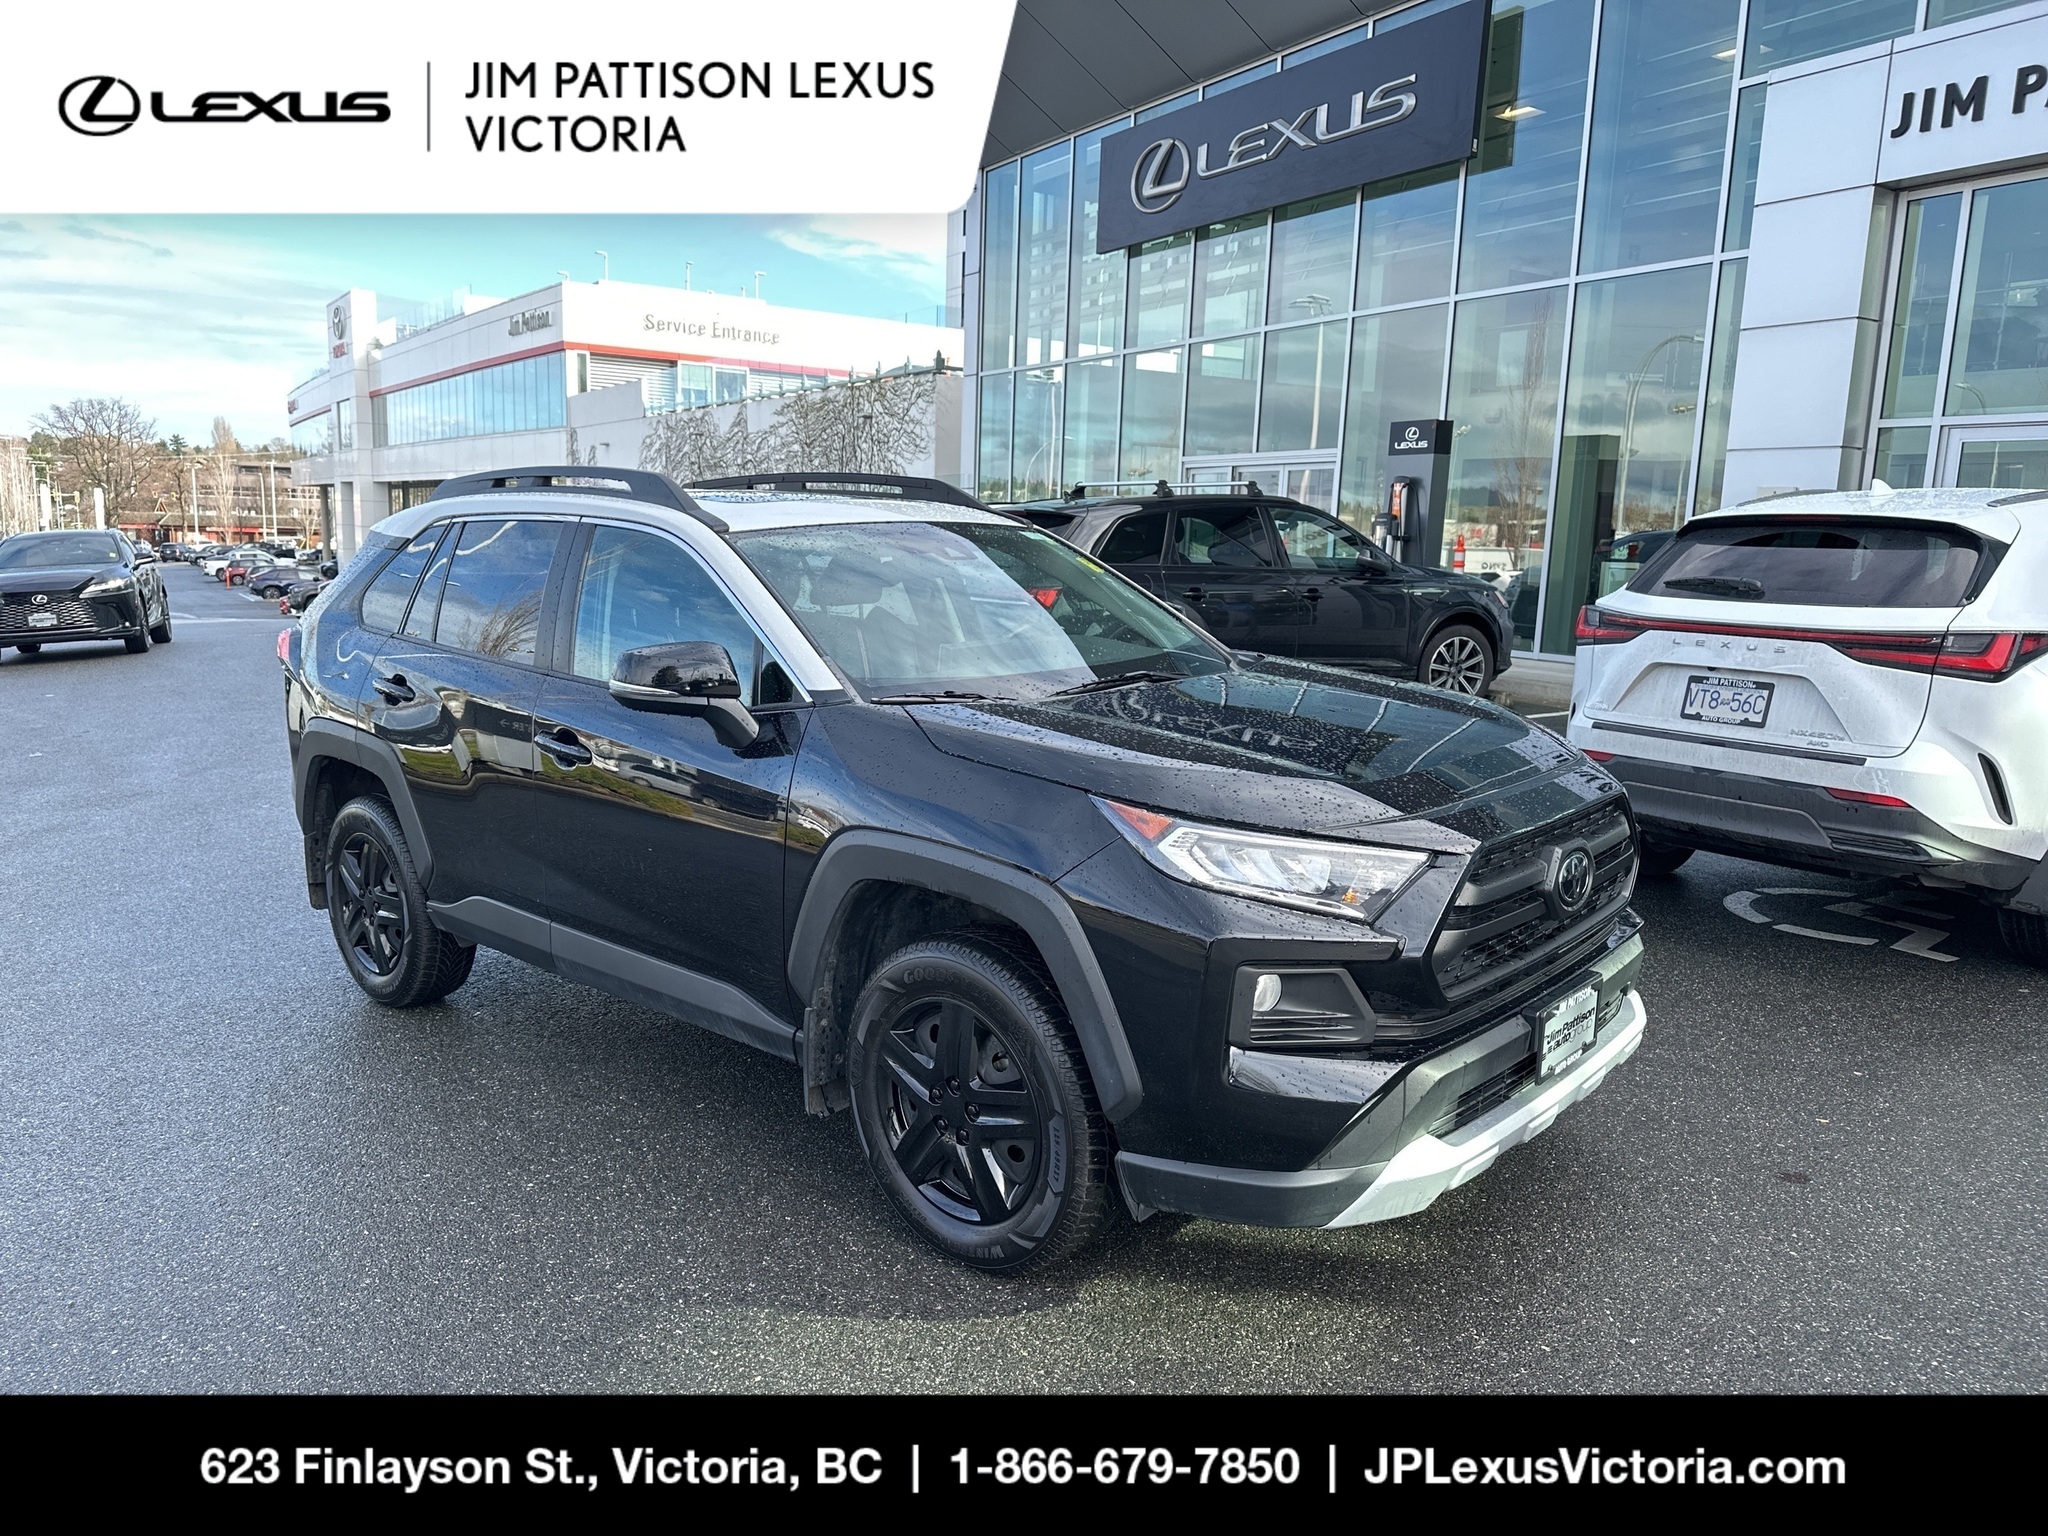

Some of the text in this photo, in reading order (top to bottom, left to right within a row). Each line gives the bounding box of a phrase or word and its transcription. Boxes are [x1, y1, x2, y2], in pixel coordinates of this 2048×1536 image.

[1890, 64, 2048, 138] JIM P
[1196, 73, 1417, 180] LEXUS
[643, 314, 780, 345] Service Entrance
[1394, 441, 1428, 449] LEXUS
[1673, 638, 1786, 654] LEXUS
[1720, 679, 1752, 688] PATTISON
[1689, 688, 1720, 710] VT8
[1730, 692, 1765, 715] 56C
[1719, 717, 1741, 725] GROUP
[1547, 1007, 1596, 1045] Jim Pattison
